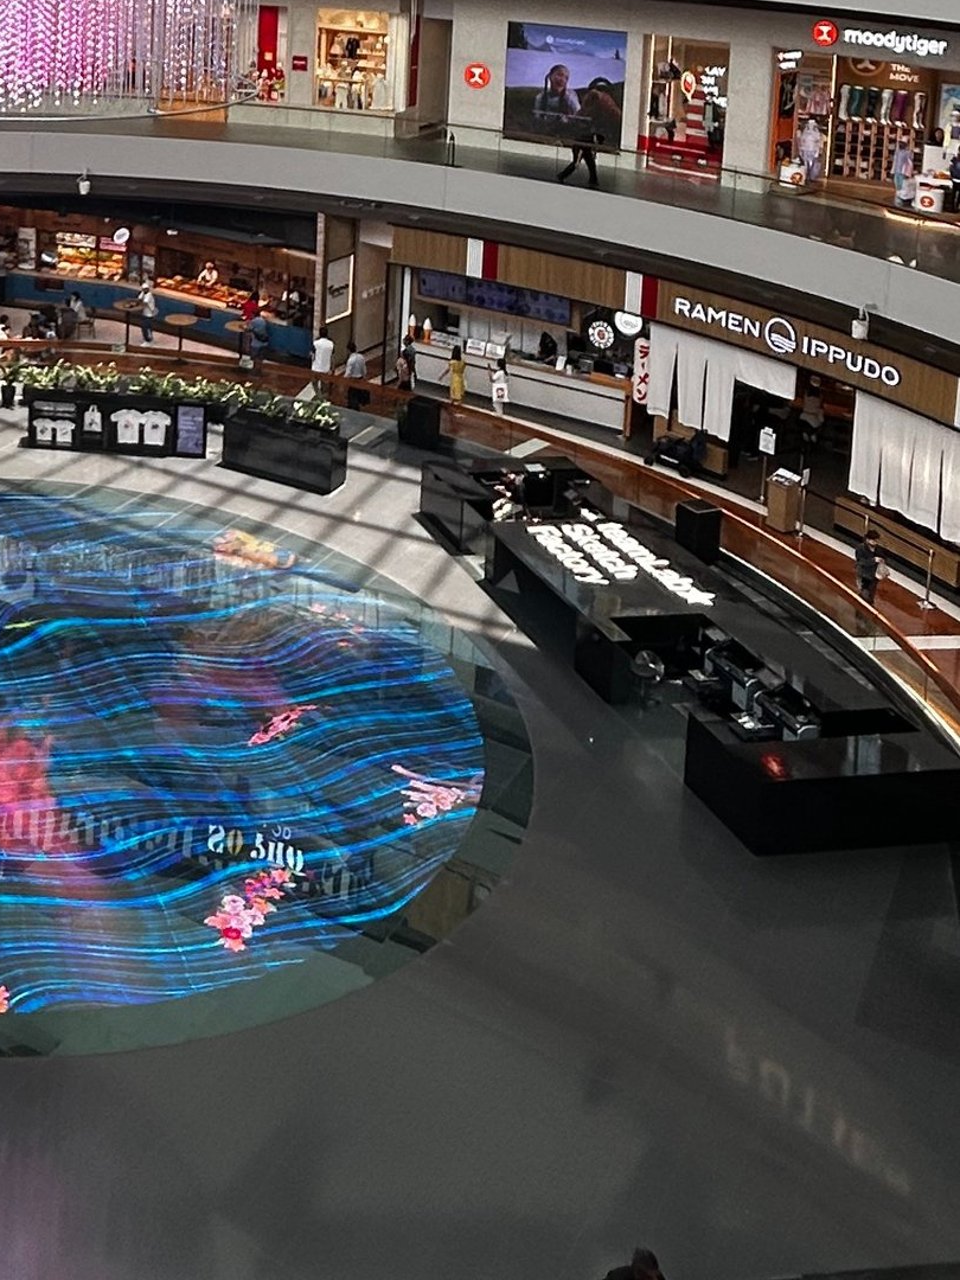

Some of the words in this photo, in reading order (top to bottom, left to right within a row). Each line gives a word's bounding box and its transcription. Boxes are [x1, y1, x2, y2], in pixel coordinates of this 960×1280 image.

[843, 29, 948, 57] moodytiger
[889, 73, 920, 84] MOVE
[674, 297, 761, 338] RAMEN
[801, 336, 901, 387] IPPUDO
[526, 524, 610, 585] Factory
